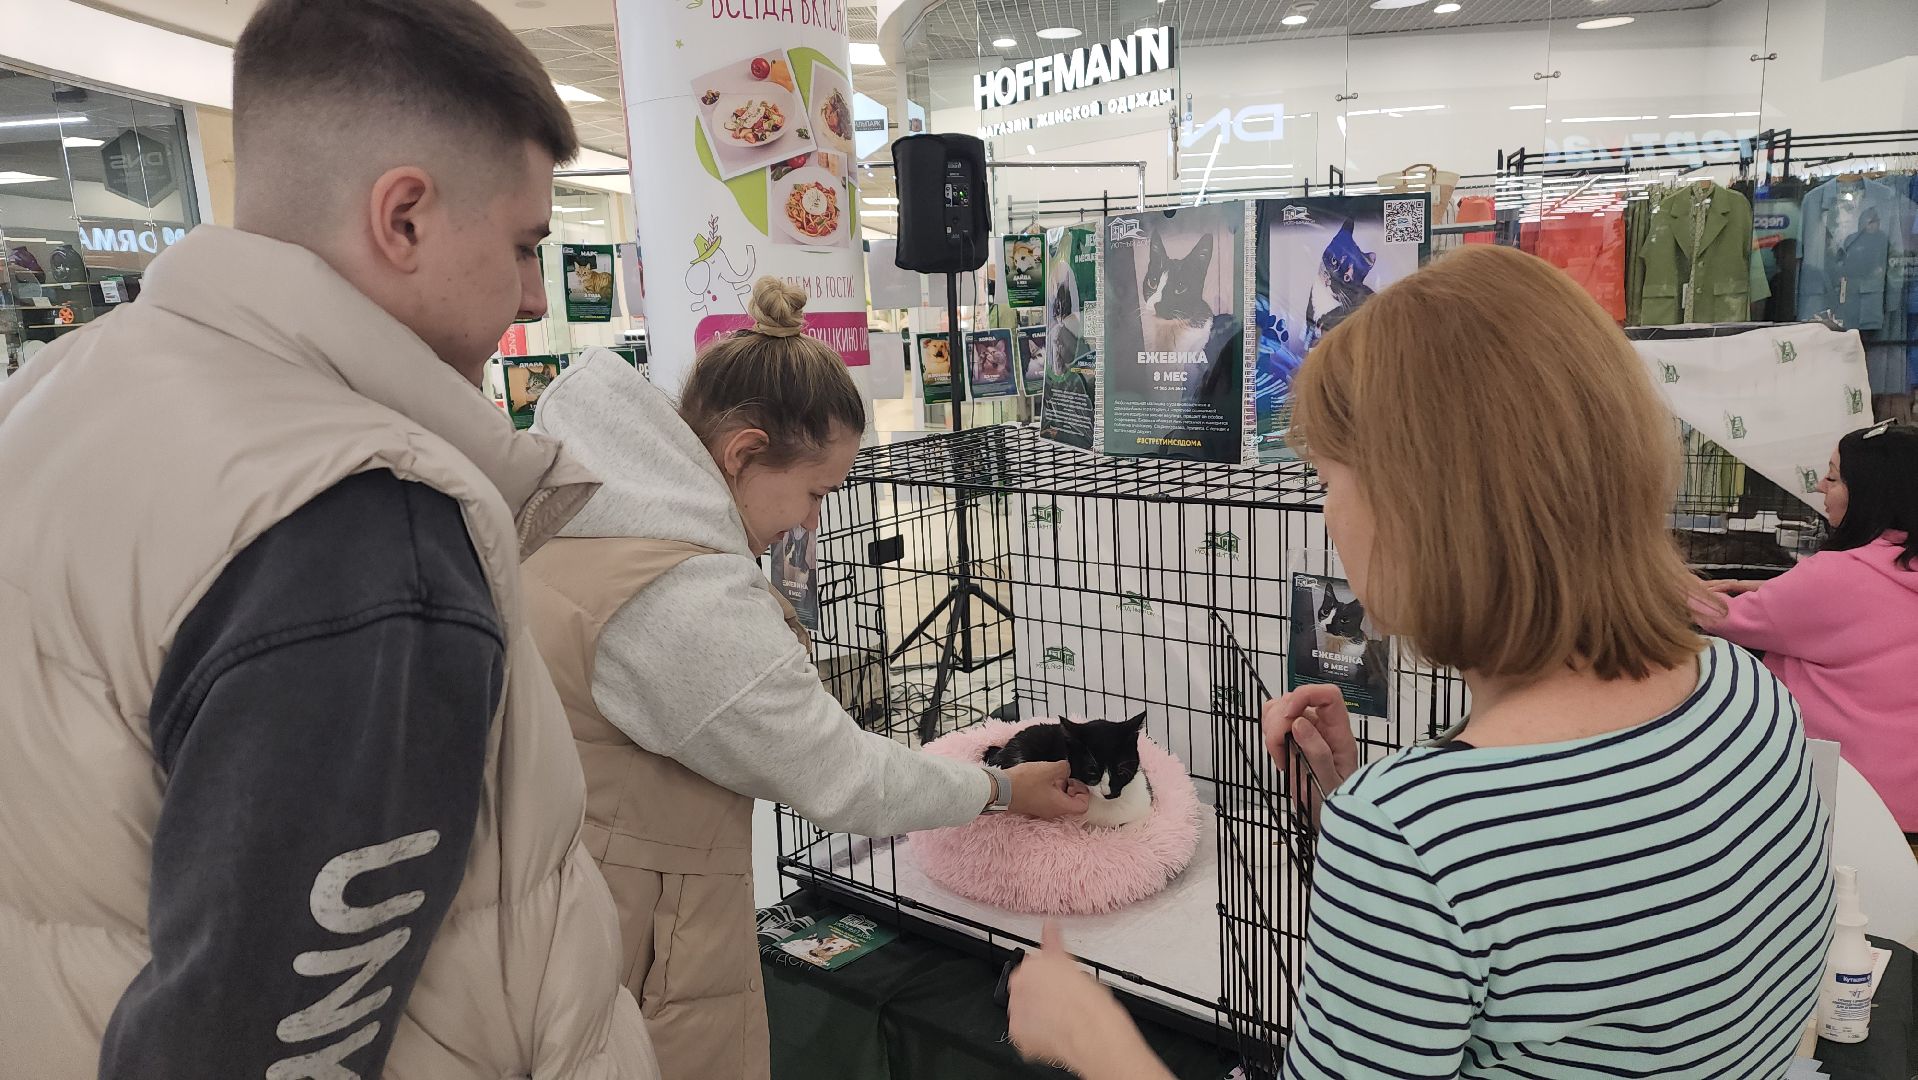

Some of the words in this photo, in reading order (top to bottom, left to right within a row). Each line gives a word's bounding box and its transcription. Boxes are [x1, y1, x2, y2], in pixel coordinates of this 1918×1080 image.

[973, 26, 1172, 111] HOFFMANN
[976, 117, 1032, 139] МАГАЗИН
[1036, 100, 1102, 128] ЖЕНСКОЙ
[1107, 87, 1174, 115] ОДЕЖДЫ
[1137, 351, 1208, 364] ЕЖЕВИКА
[1153, 372, 1161, 382] 8
[1163, 371, 1188, 382] МЕС
[1311, 649, 1364, 666] ЕЖЕВИКА
